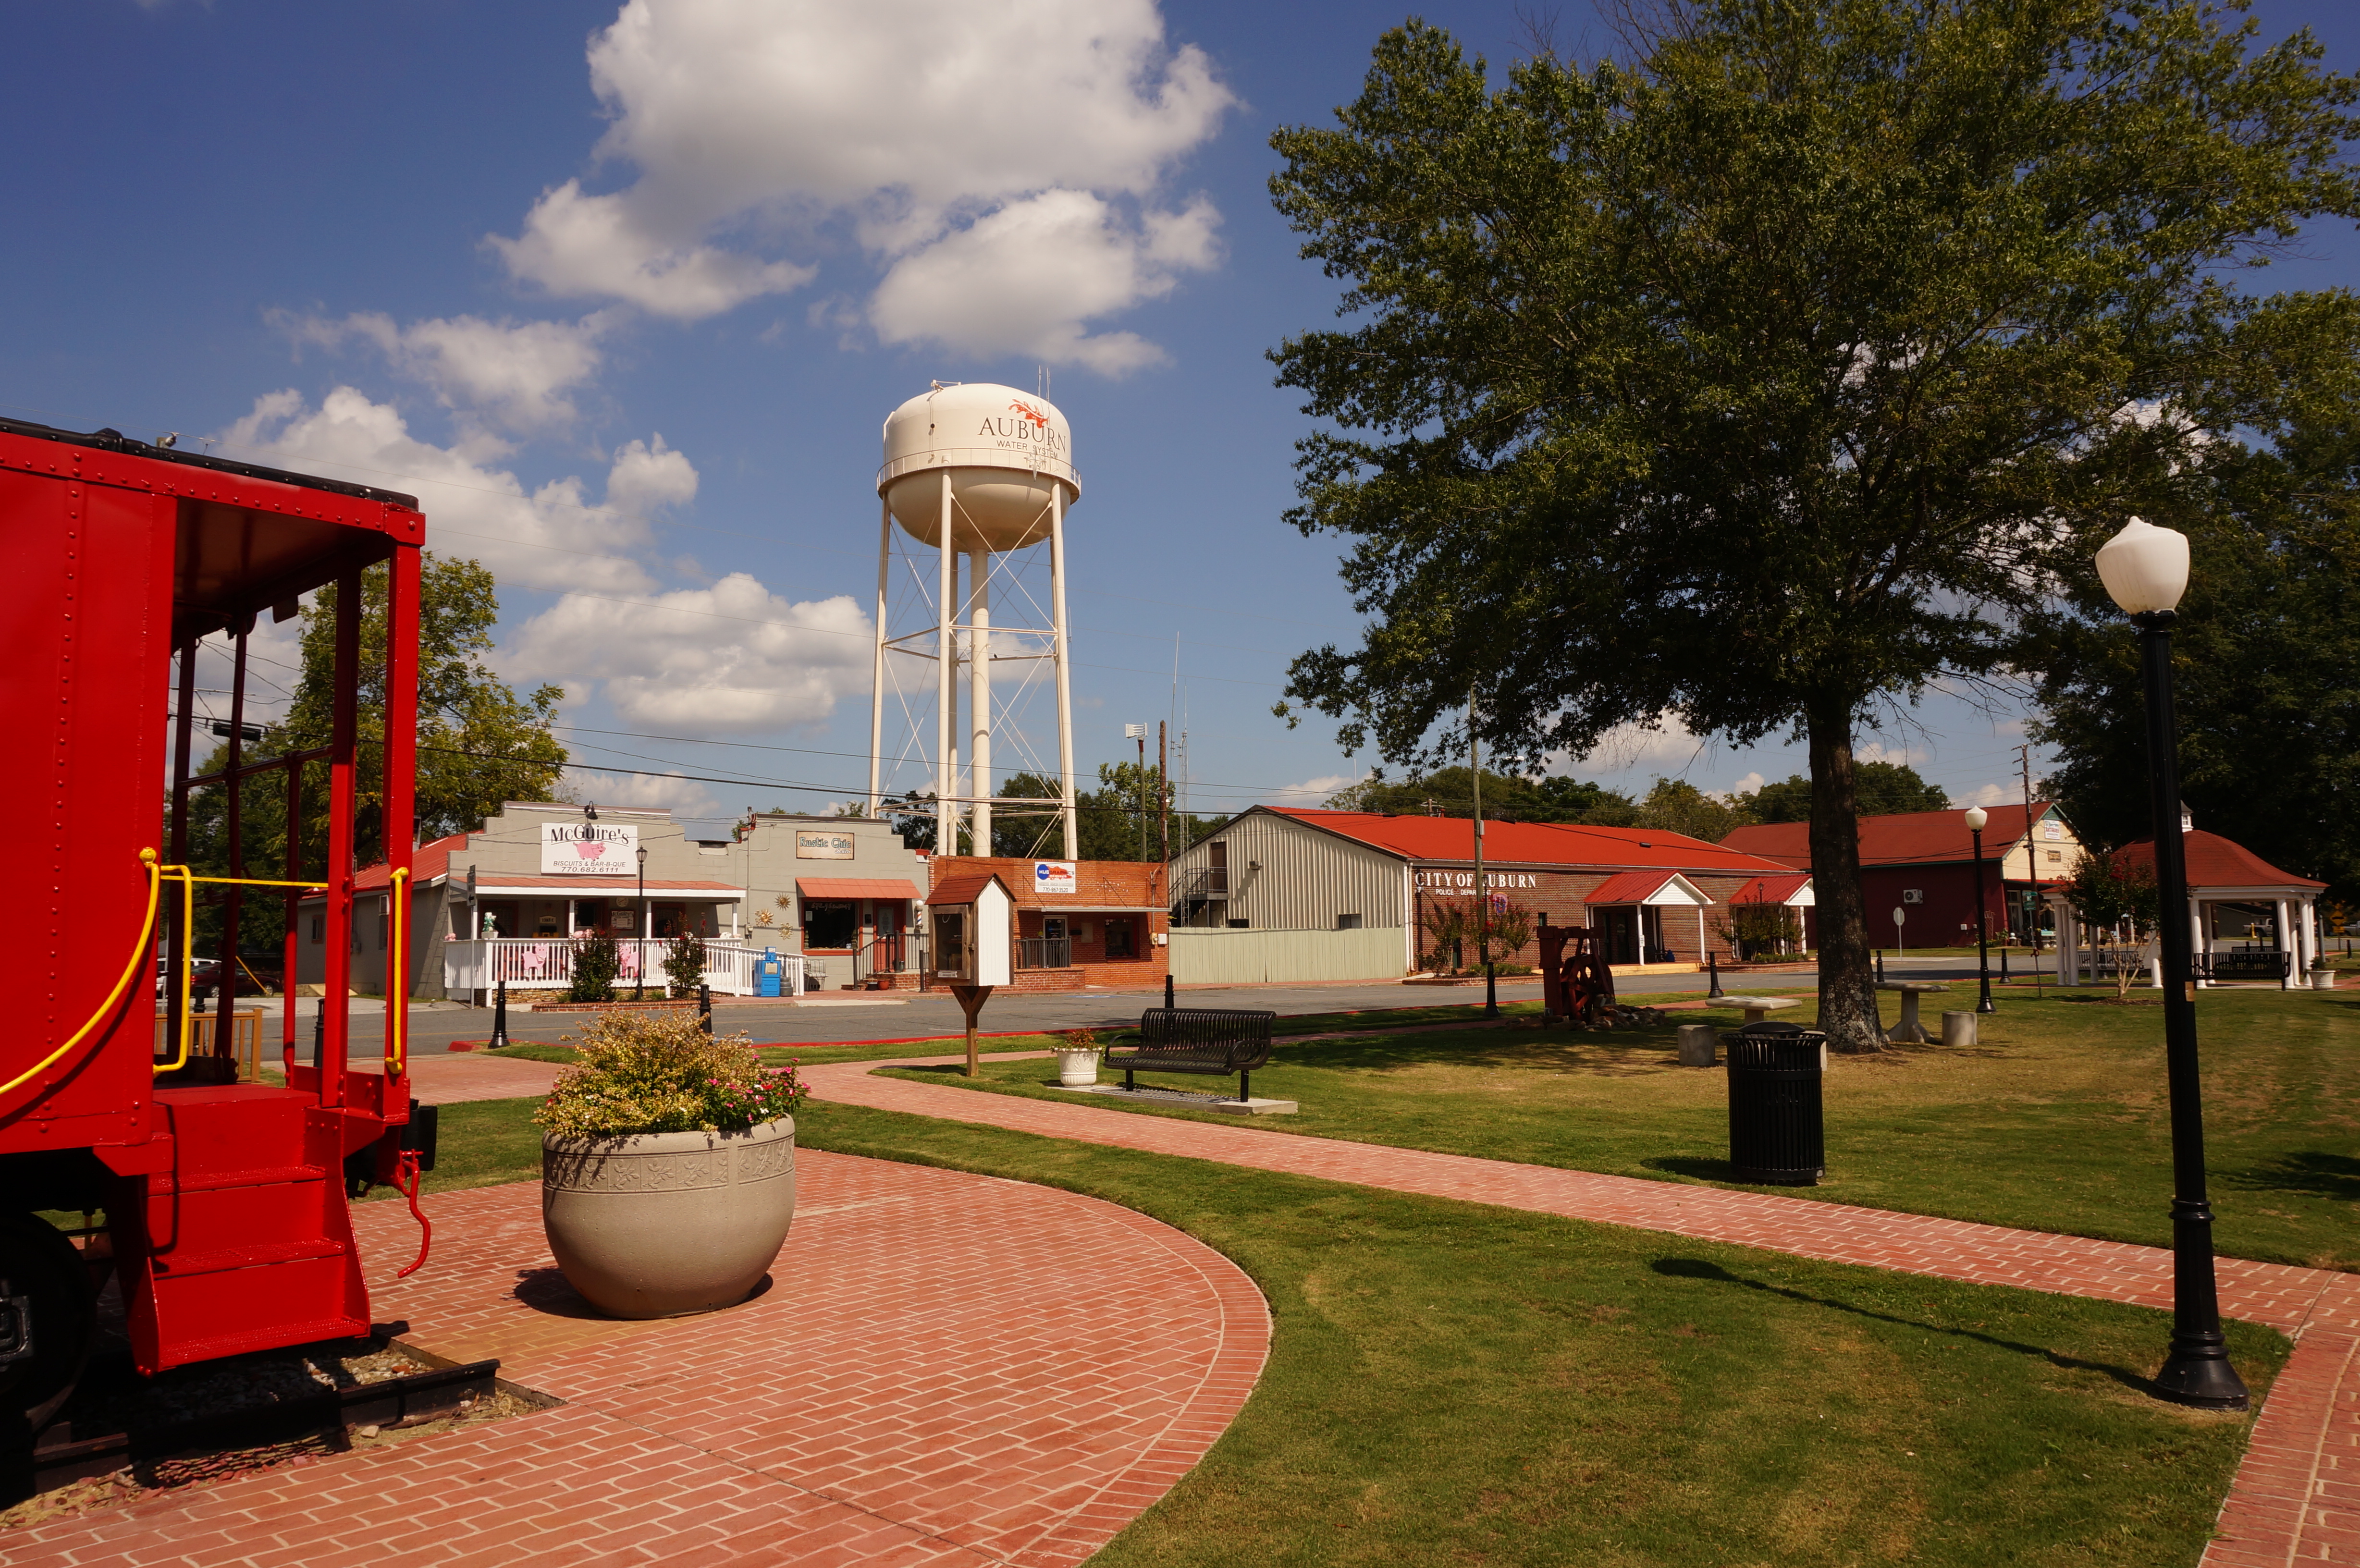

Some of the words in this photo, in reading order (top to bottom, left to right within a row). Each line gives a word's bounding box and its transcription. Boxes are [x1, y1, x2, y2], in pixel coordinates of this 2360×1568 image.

[978, 417, 1066, 453] AUBURN
[996, 440, 1028, 450] WATER
[1032, 445, 1058, 459] SYSTEM
[551, 825, 629, 845] McGuire's
[799, 836, 828, 847] Rustic
[831, 837, 851, 848] Chic
[1415, 872, 1452, 886] CITY
[1456, 873, 1473, 887] OF
[1483, 874, 1536, 888] UBURN
